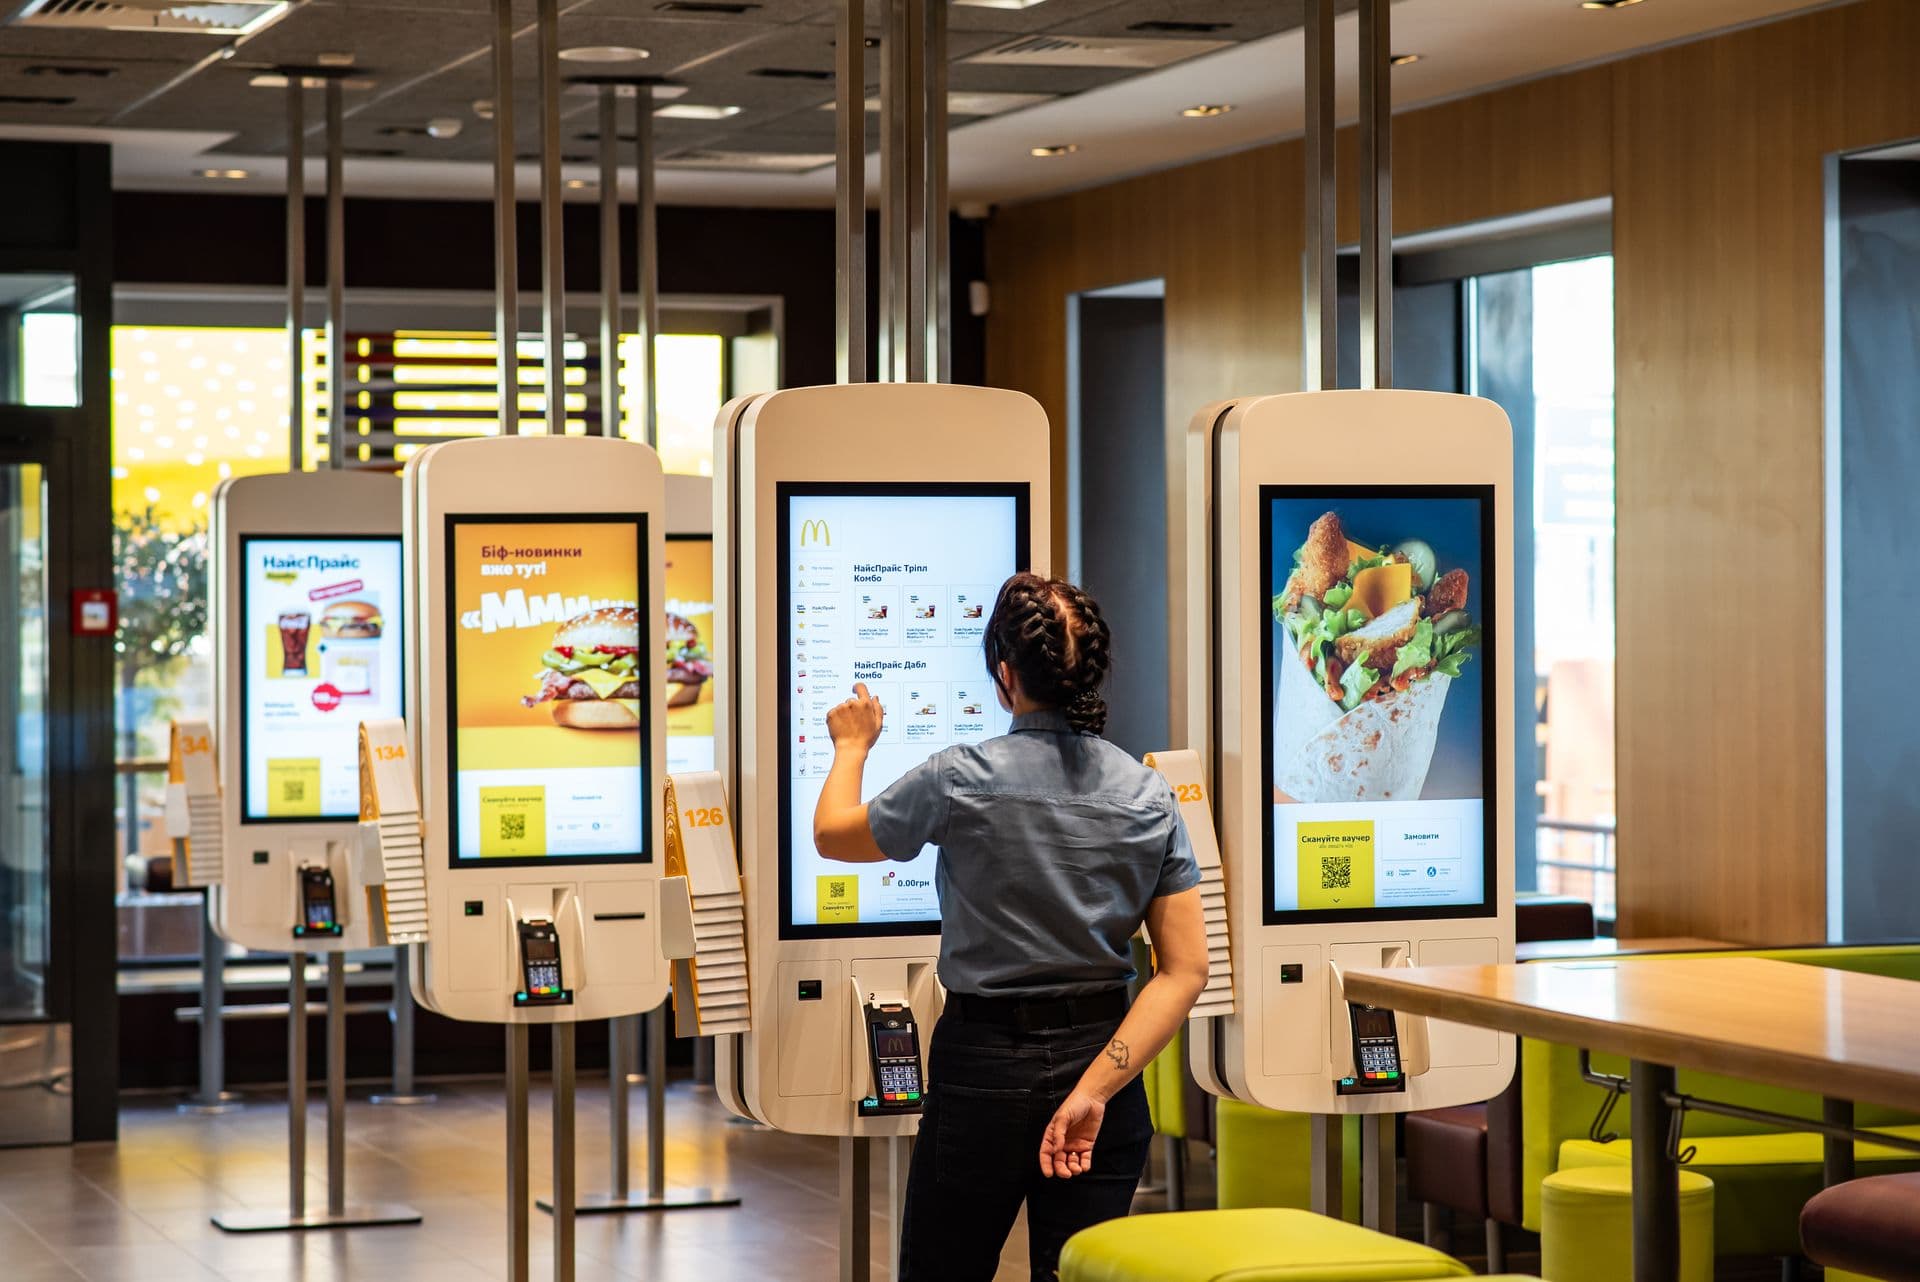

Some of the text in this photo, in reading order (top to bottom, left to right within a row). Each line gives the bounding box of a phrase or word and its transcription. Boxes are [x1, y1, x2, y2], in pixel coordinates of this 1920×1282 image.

[481, 545, 582, 560] Біф-новинки
[263, 553, 360, 573] НайсПрайс
[481, 561, 547, 579] вже тут!
[854, 564, 928, 574] НайсПрайс Тріпл
[854, 574, 882, 582] Комбо
[854, 660, 927, 671] НайсПрайс Дабл
[854, 671, 882, 680] Комбо
[375, 745, 406, 761] 134
[684, 807, 724, 827] 126
[1301, 834, 1370, 844] Скануйте ваучер
[897, 879, 930, 888] 0.00грн
